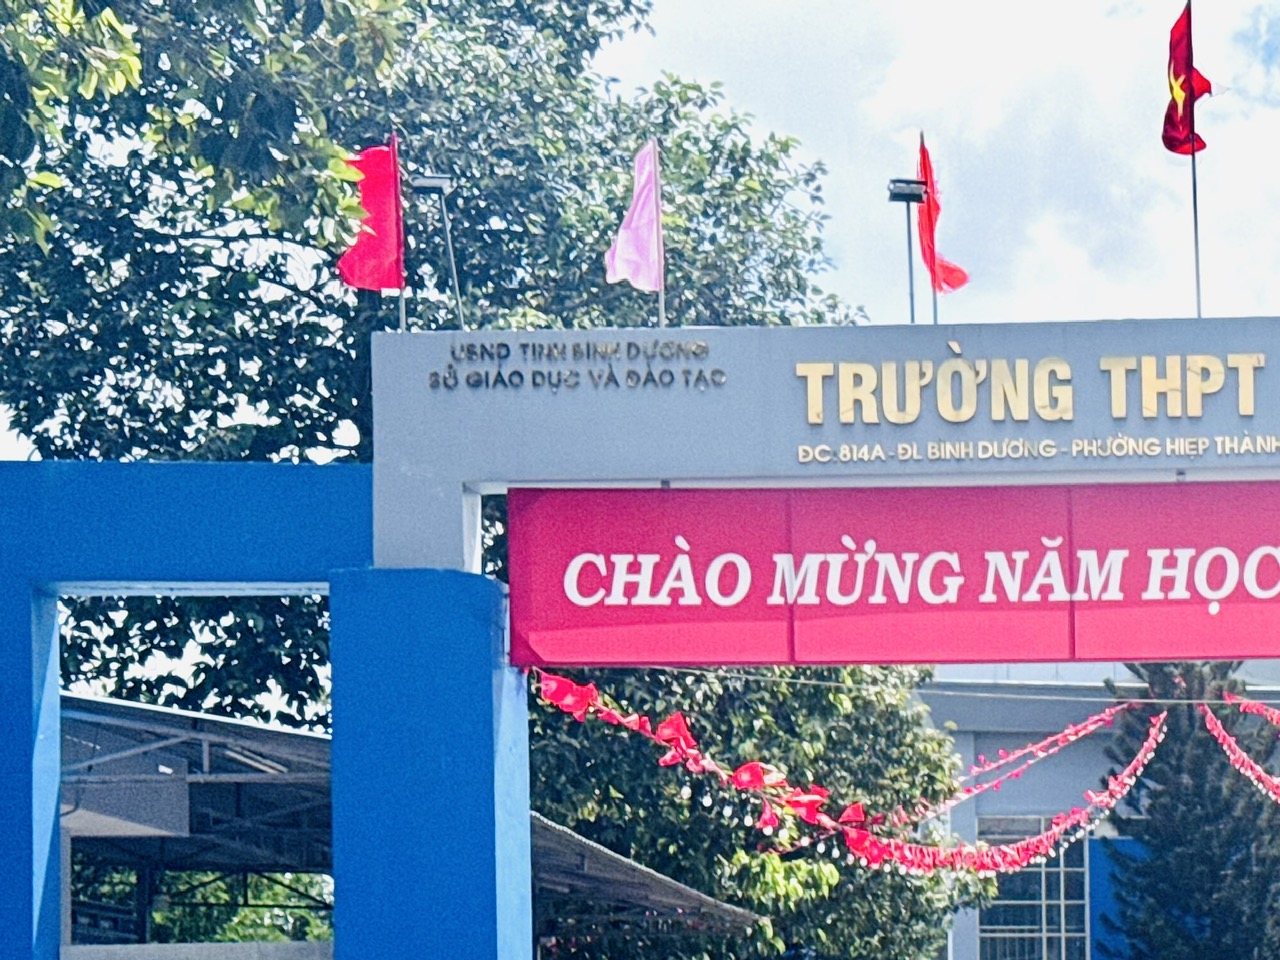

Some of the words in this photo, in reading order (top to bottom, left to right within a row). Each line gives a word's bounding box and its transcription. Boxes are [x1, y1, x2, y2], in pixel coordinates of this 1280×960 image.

[532, 369, 580, 392] DỤC
[587, 362, 620, 388] VÀ
[682, 368, 727, 391] TẠO
[795, 341, 1074, 425] TRƯỜNG
[1100, 353, 1266, 419] THPT
[977, 437, 1058, 460] DƯƠNG
[1071, 431, 1162, 457] PHƯỜNG
[563, 535, 753, 606] CHÀO
[769, 534, 965, 605] MỪNG
[981, 536, 1130, 602] NĂM
